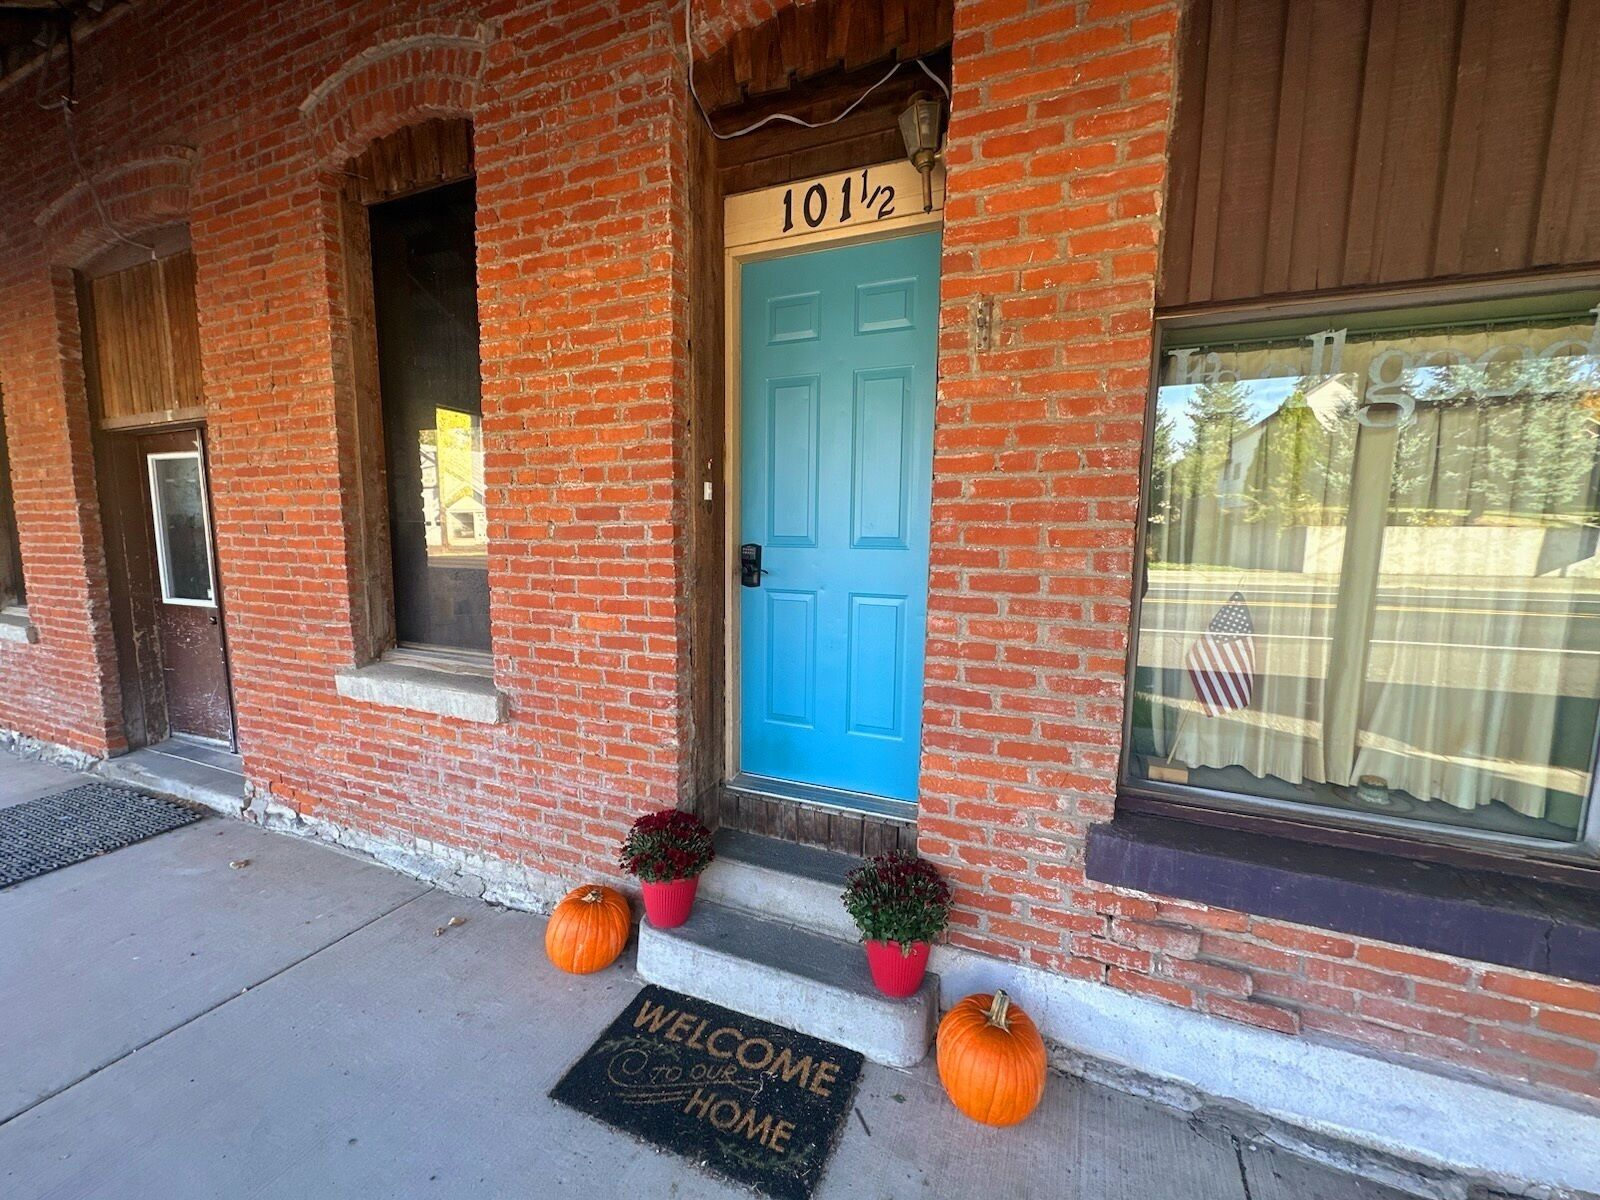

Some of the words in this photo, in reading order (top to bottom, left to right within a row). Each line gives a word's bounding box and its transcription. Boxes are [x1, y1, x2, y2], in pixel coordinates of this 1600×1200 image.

[631, 1000, 840, 1098] WELCOME
[651, 1064, 681, 1083] TO
[690, 1063, 737, 1083] OUR
[683, 1088, 796, 1153] HOME
